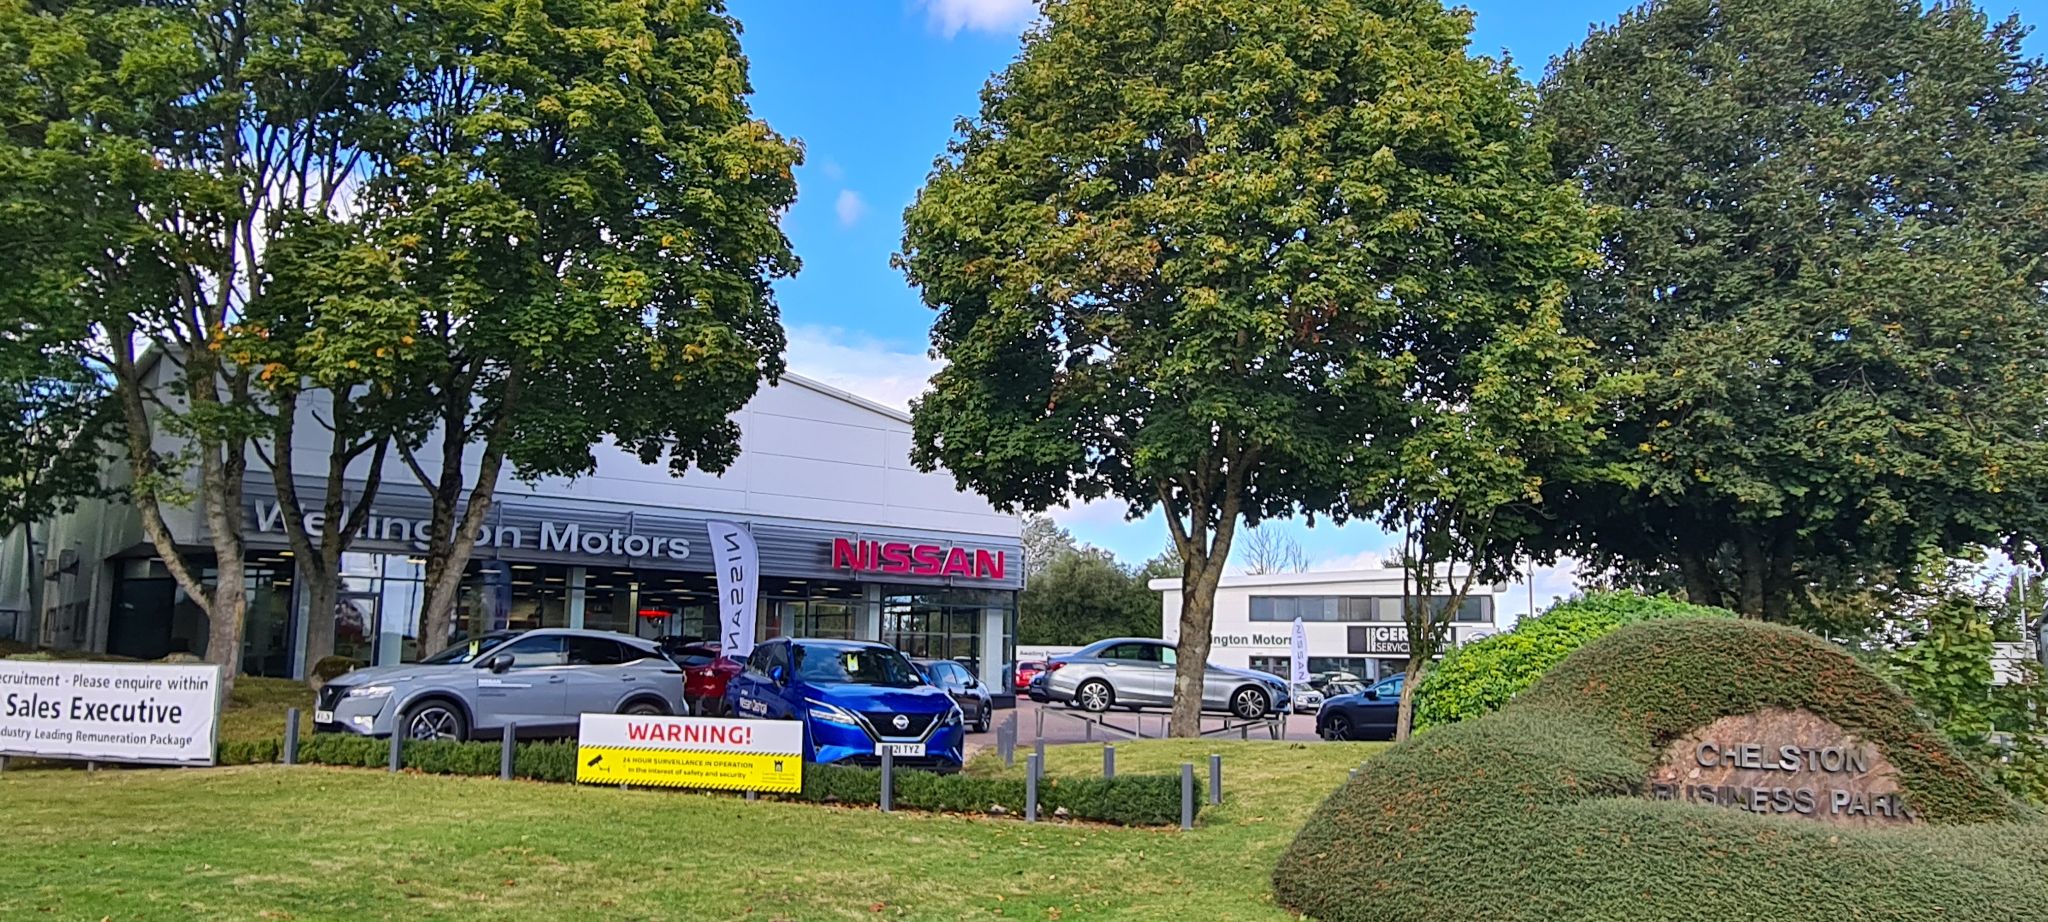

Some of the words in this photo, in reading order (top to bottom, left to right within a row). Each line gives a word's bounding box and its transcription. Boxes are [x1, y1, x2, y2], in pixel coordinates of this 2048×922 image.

[540, 521, 690, 559] Motors
[832, 537, 1005, 579] NISSAN
[1295, 624, 1305, 681] NISSAN
[1376, 642, 1411, 653] SERVIC
[0, 671, 60, 687] cruitment
[73, 674, 110, 689] Please
[115, 675, 162, 692] enquire
[167, 675, 209, 691] within
[6, 693, 61, 719] Sales
[70, 696, 182, 724] Executive
[35, 728, 72, 744] Leading
[75, 731, 147, 745] Remuneration
[150, 733, 193, 748] Package
[628, 722, 752, 744] WARNING!
[632, 757, 651, 765] HOUR
[654, 758, 704, 767] SURVEILLANCE
[713, 761, 753, 769] OPERATION
[1696, 741, 1869, 773] CHELSTON
[648, 767, 674, 775] interest
[684, 769, 704, 778] safety
[705, 770, 718, 778] and
[719, 771, 746, 780] security
